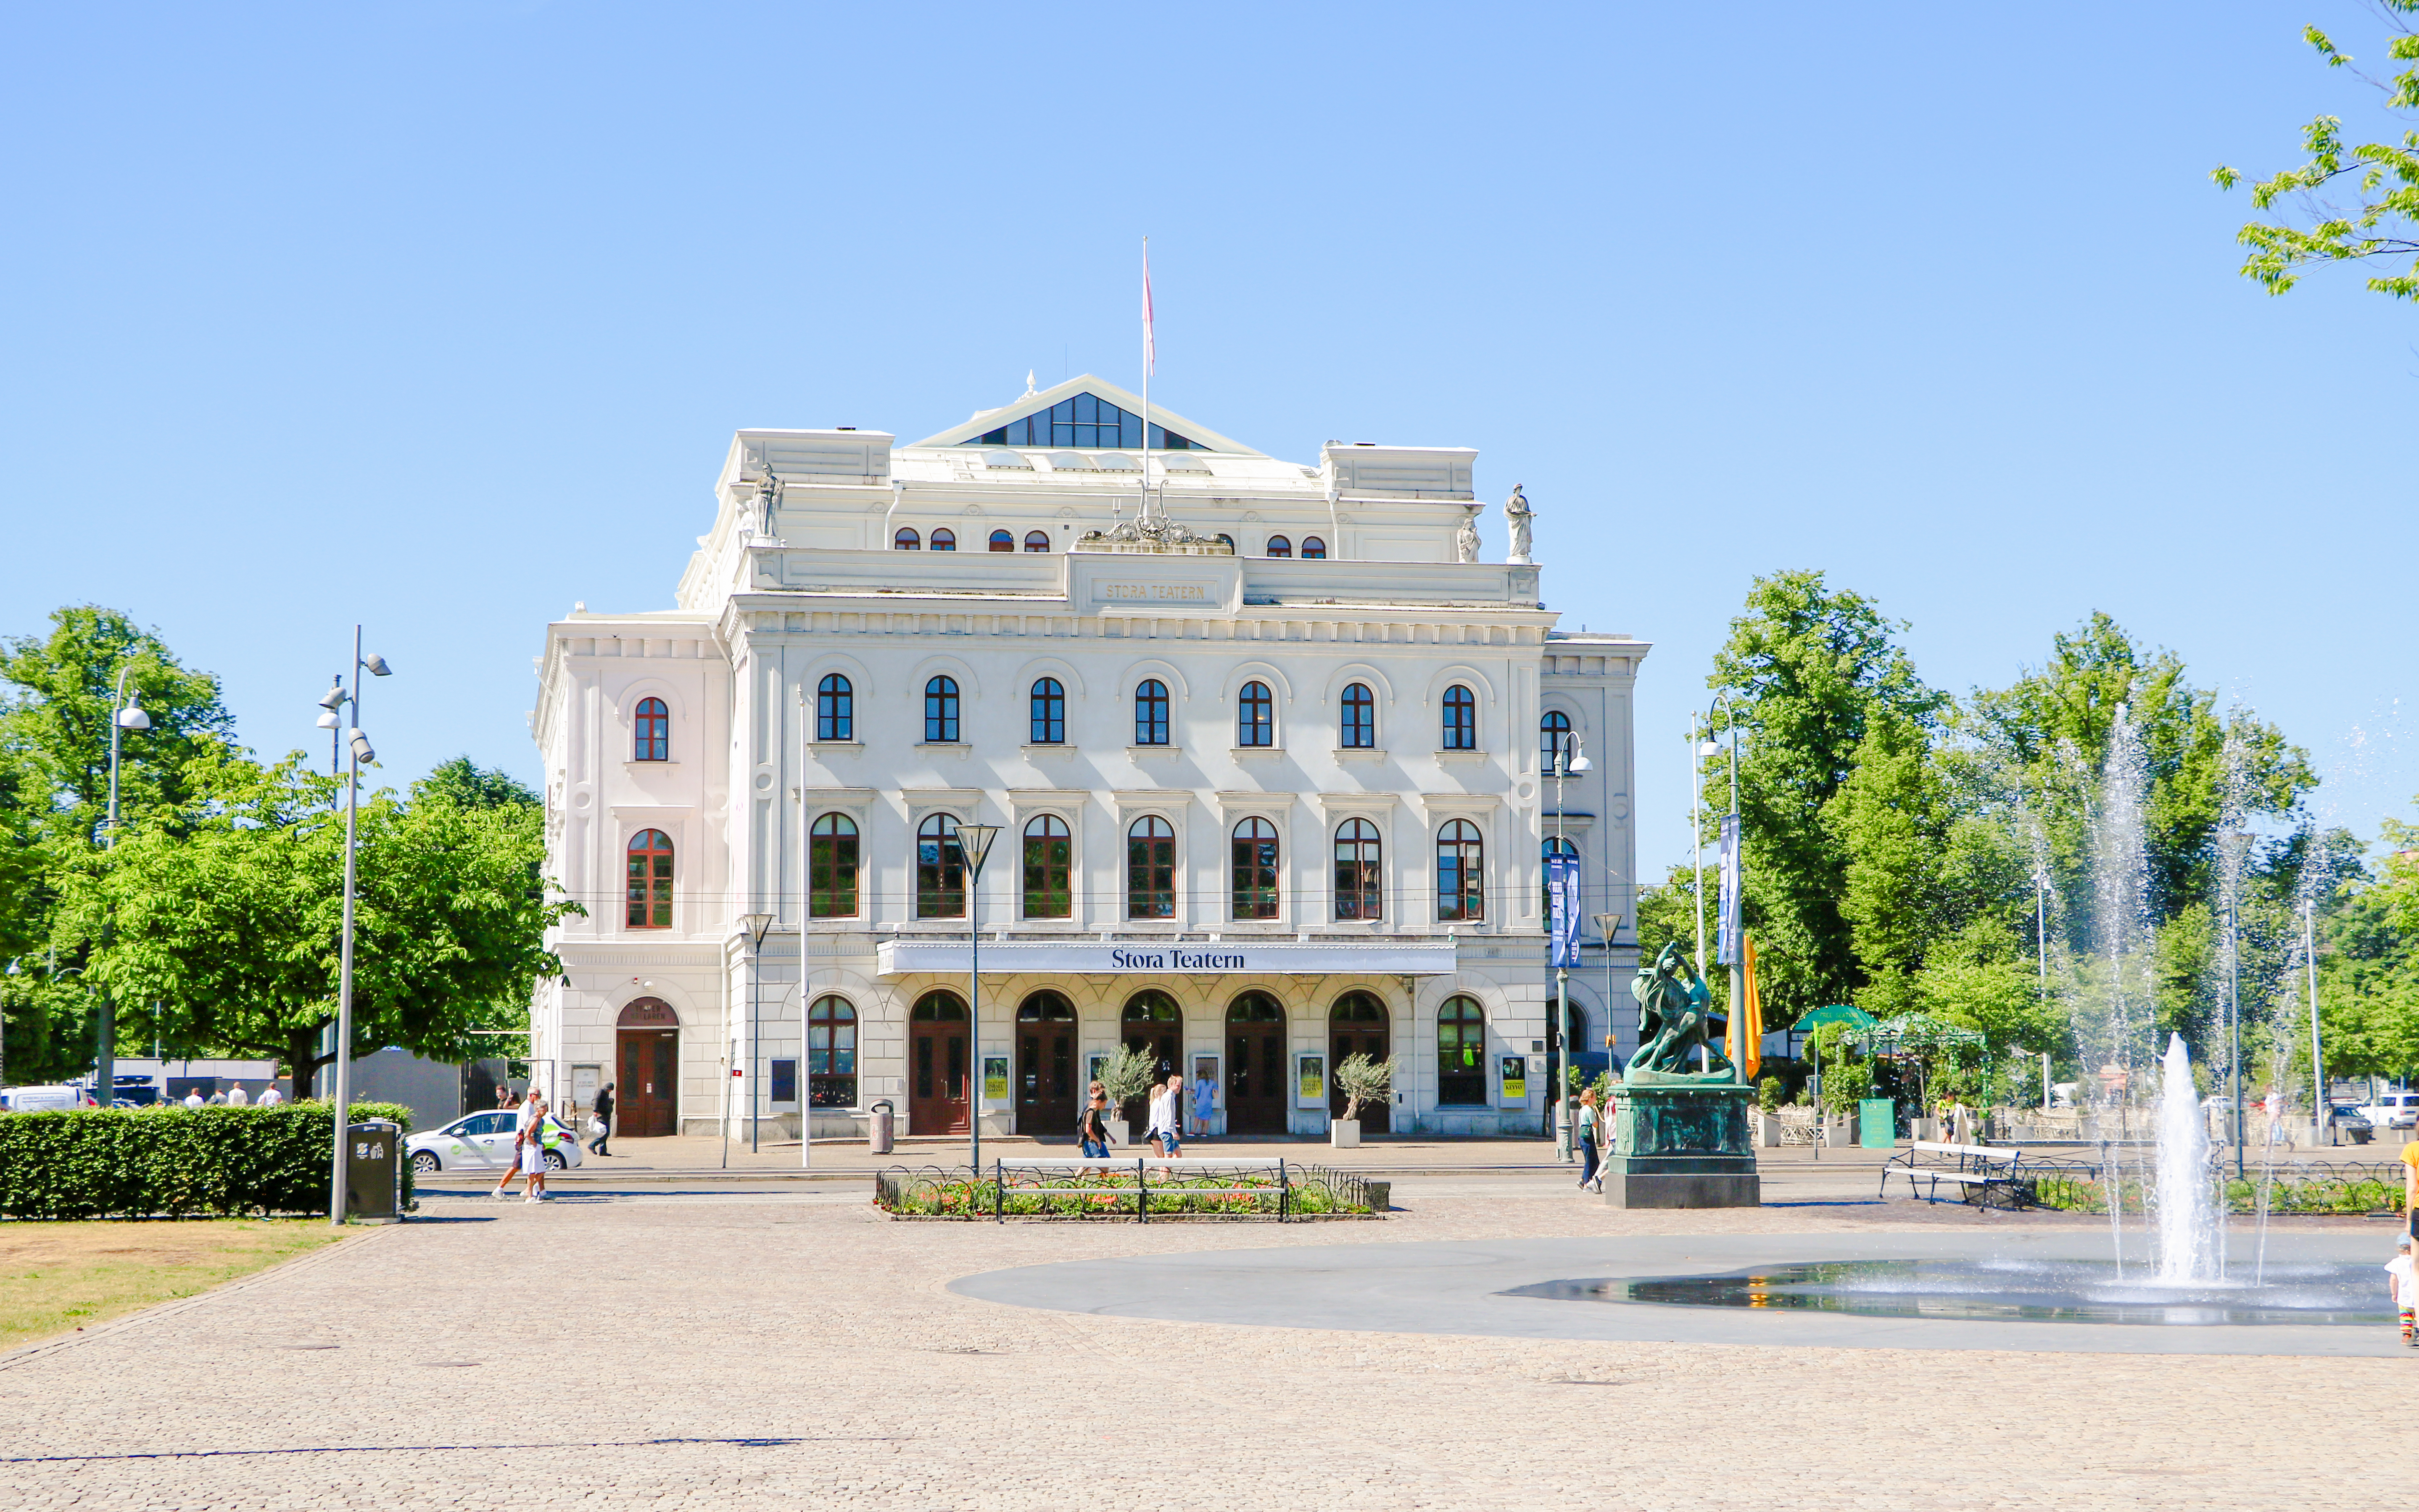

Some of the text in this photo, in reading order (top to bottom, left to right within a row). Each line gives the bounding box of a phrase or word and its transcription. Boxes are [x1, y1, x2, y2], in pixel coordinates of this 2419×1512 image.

[1106, 585, 1204, 599] STORA TEATERN
[1552, 881, 1562, 893] VOLVO
[1112, 949, 1245, 968] Stora Teatern
